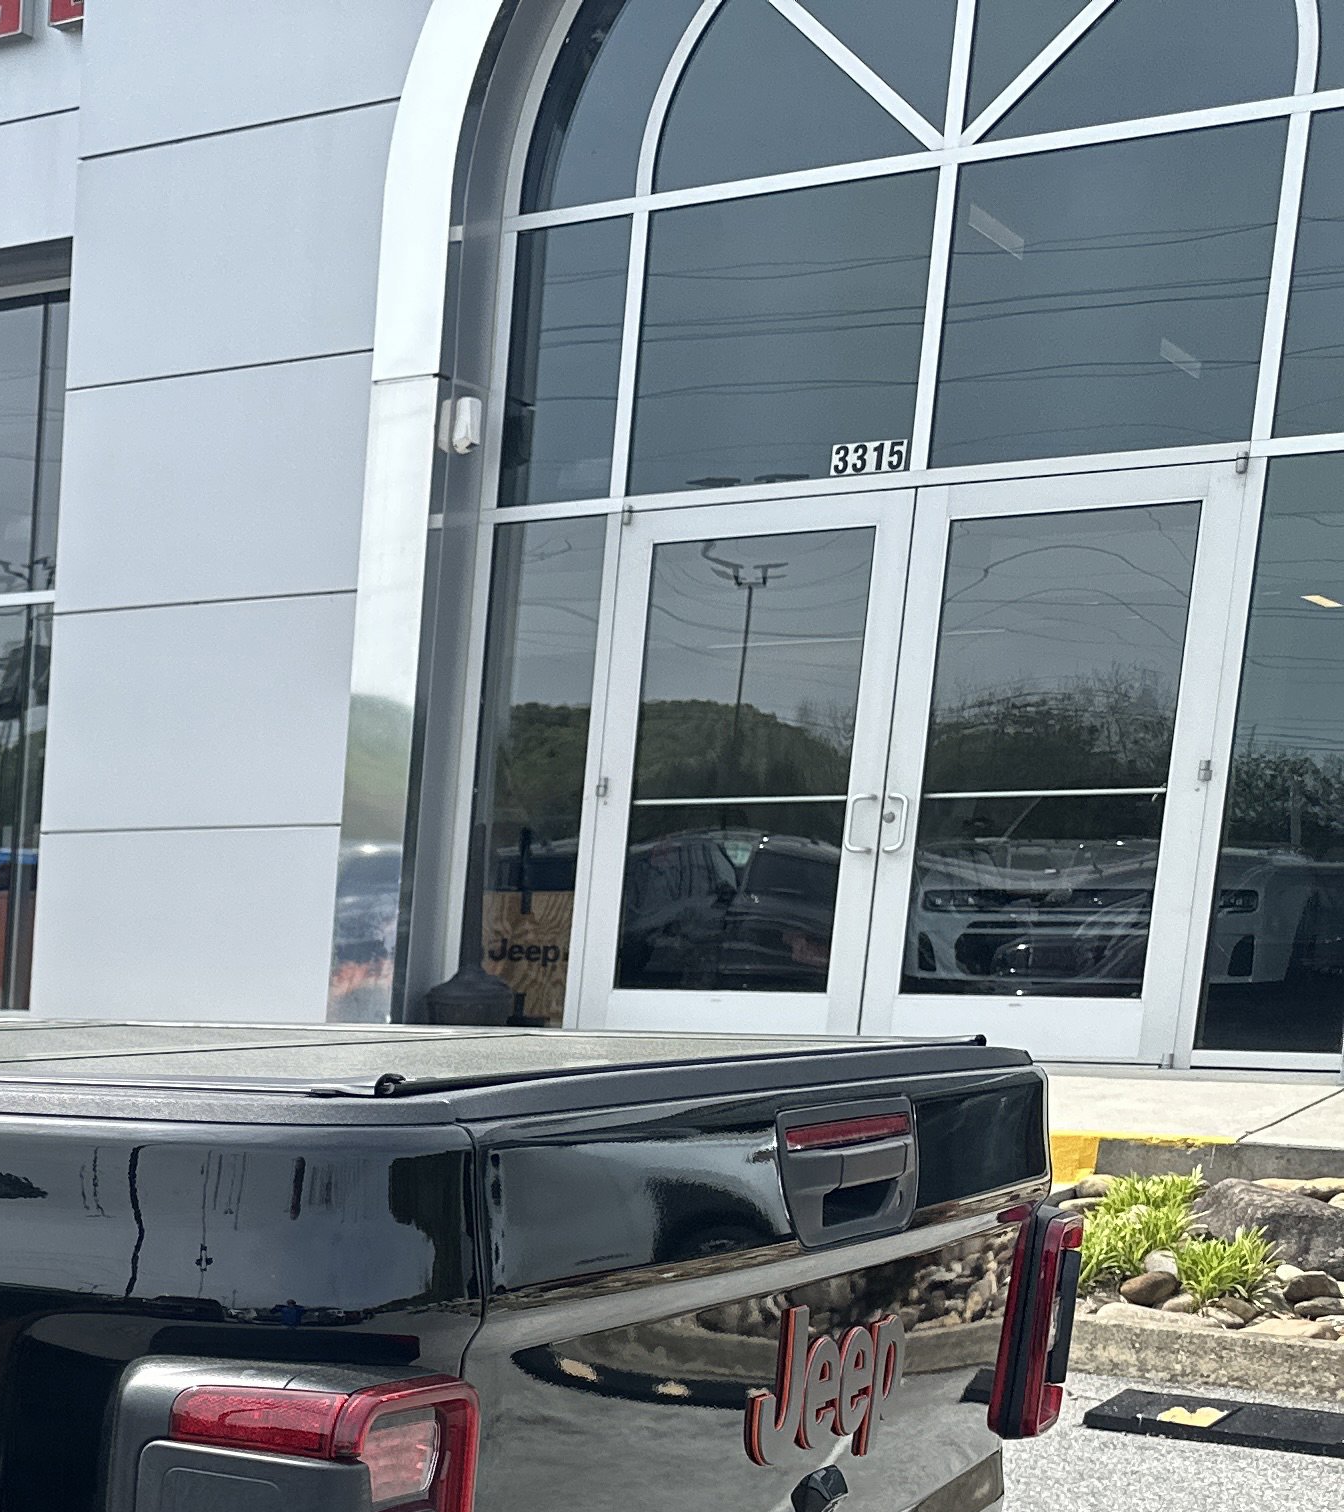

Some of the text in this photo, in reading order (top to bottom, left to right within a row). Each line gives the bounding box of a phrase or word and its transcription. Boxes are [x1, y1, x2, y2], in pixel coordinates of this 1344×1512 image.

[833, 440, 904, 474] 3315
[488, 937, 561, 967] Jeep
[743, 1305, 905, 1467] Jeep
